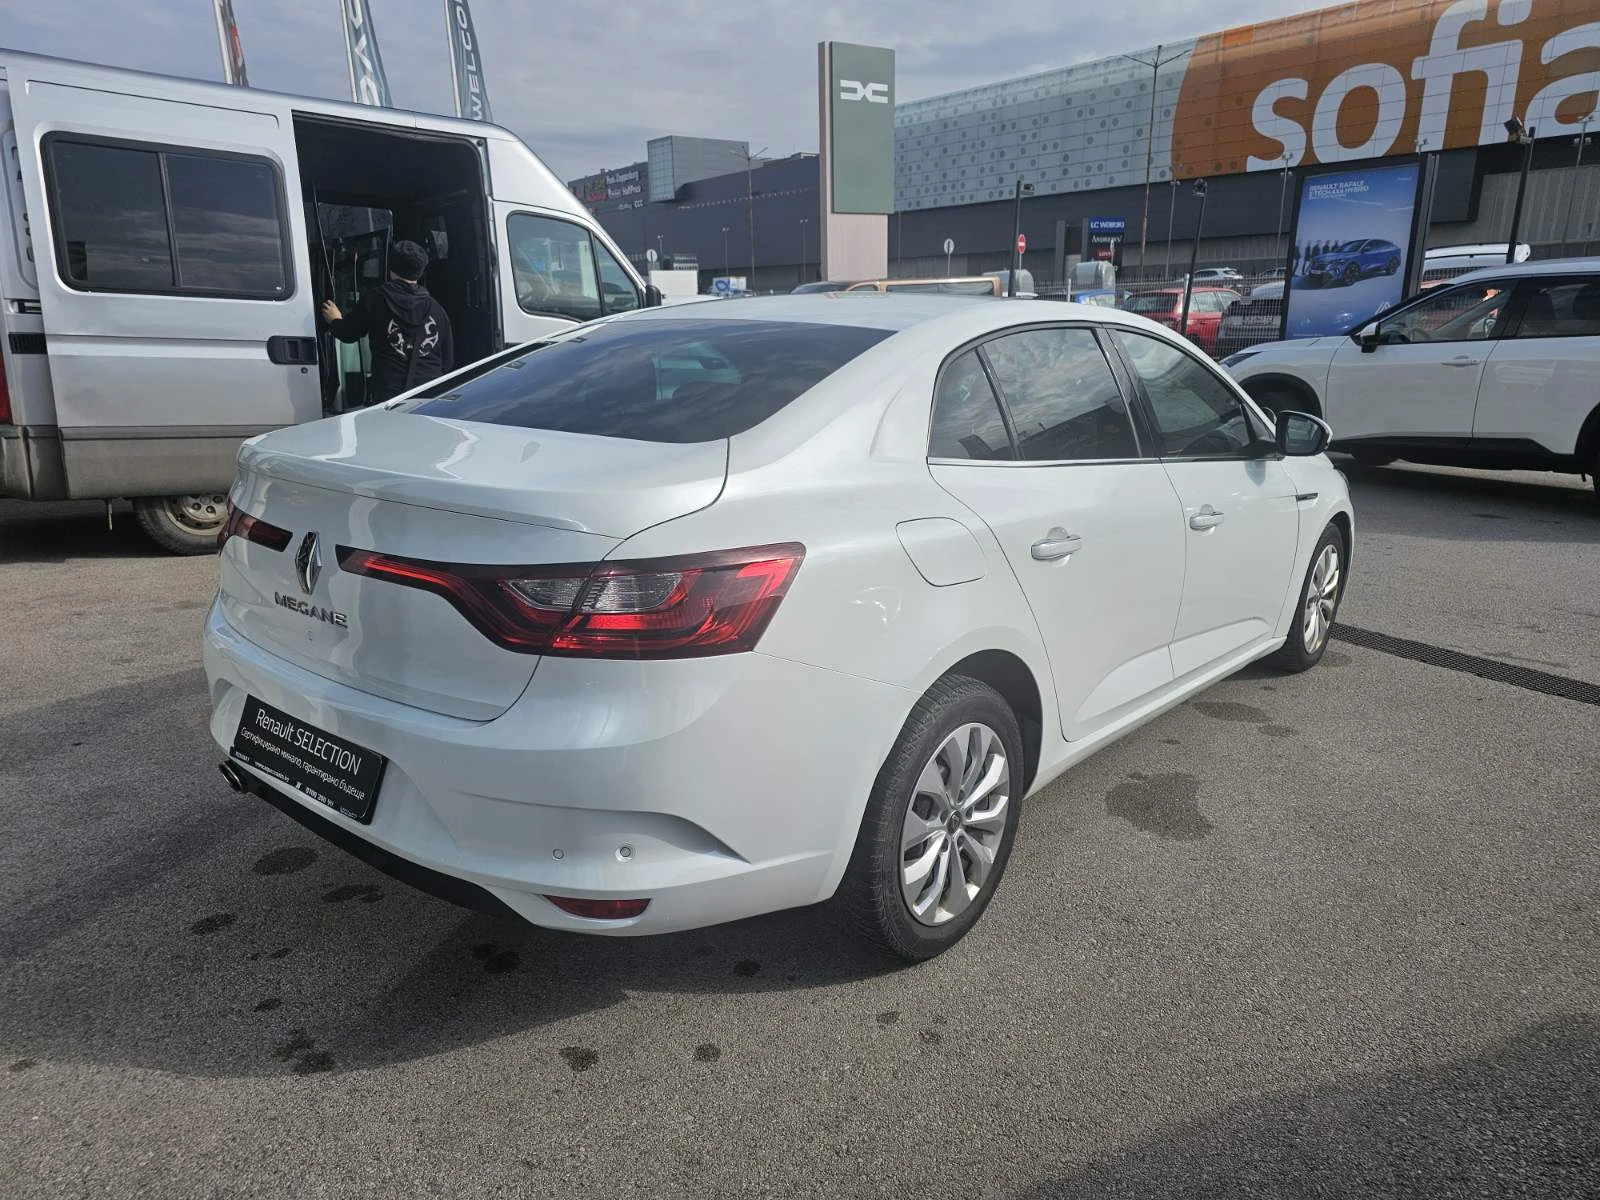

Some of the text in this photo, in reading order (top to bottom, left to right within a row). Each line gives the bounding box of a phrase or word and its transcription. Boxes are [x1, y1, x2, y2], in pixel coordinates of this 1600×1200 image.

[455, 0, 483, 120] WELCO
[1247, 0, 1600, 172] sofia
[274, 591, 349, 629] MEGANE
[255, 708, 295, 742] Renault
[293, 728, 362, 776] SELECTION
[302, 761, 339, 787] гарантирано
[339, 779, 365, 800] бъдеще
